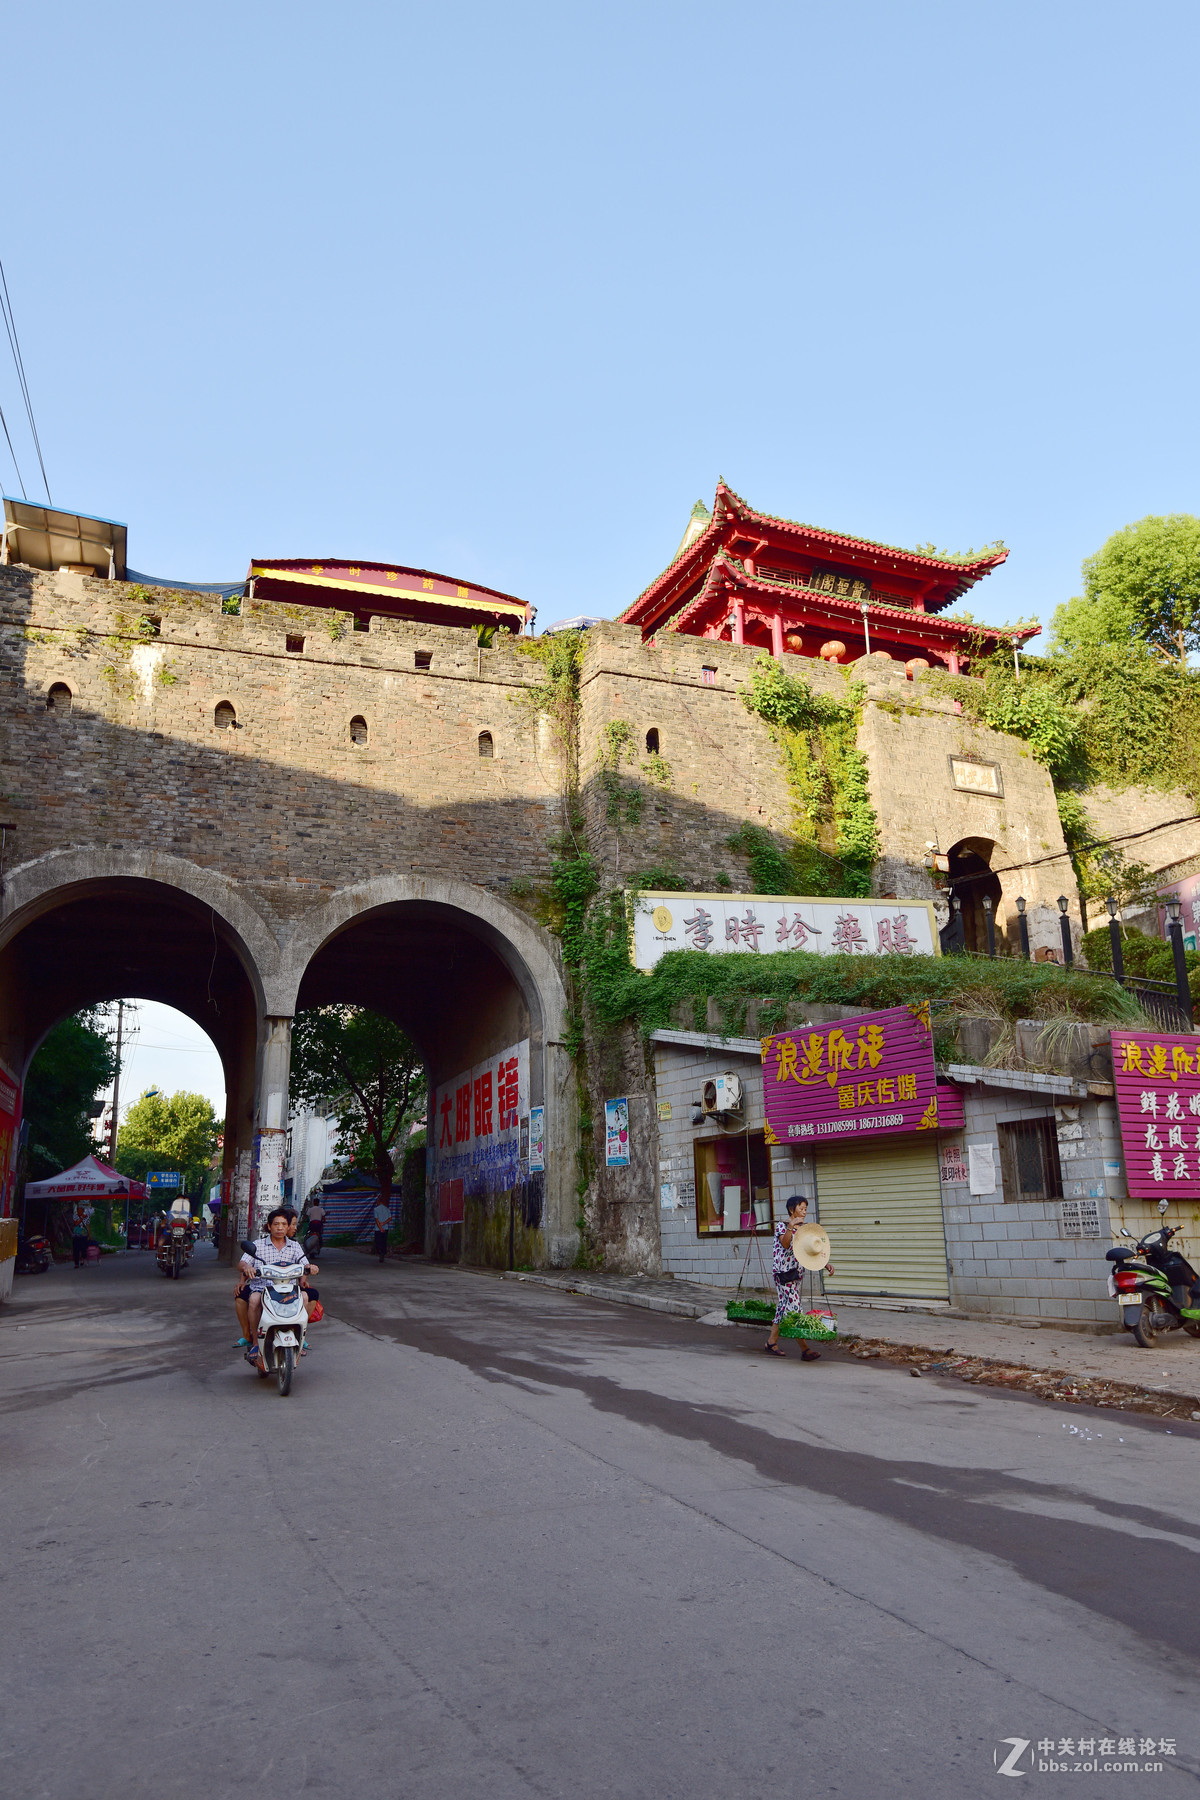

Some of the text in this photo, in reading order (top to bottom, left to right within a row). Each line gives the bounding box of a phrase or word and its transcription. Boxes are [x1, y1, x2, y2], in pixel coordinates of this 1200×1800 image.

[311, 565, 469, 598] 李时珍药膳
[683, 908, 918, 955] 李時珍藥膳
[1121, 1041, 1200, 1079] 浪漫欣
[440, 1056, 519, 1149] 大明眼镜
[816, 1120, 858, 1135] 13117085991
[859, 1113, 904, 1130] 18671316869
[1148, 1152, 1200, 1182] 喜庆
